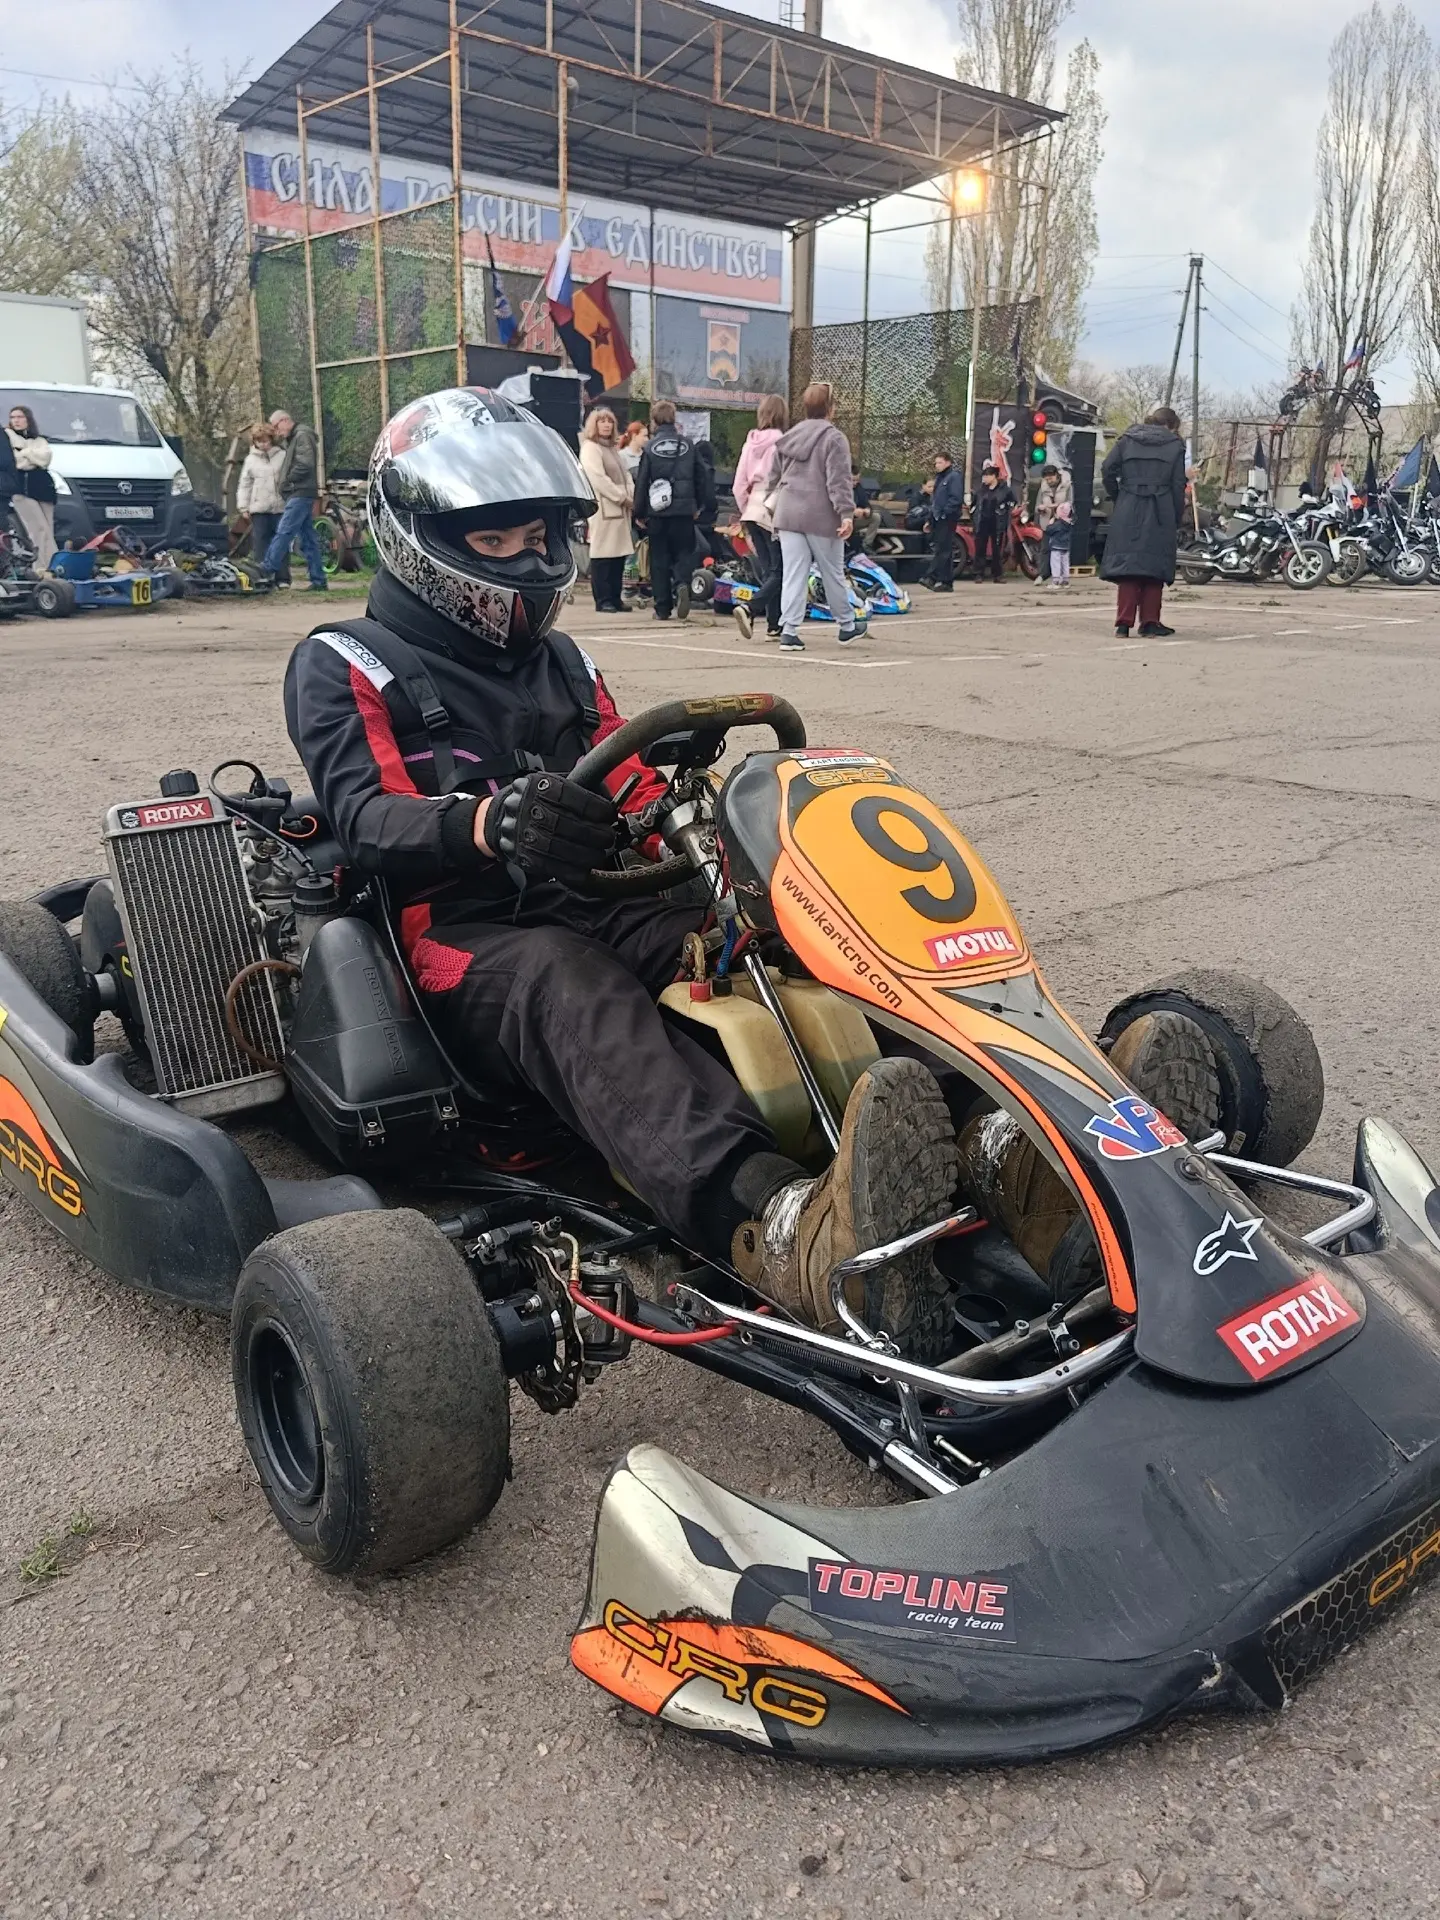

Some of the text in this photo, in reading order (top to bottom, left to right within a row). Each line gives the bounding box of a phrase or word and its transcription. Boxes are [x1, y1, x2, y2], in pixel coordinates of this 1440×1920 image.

[135, 581, 150, 601] 16
[333, 632, 378, 666] sparco
[805, 767, 892, 787] CRG
[143, 802, 207, 824] ROTAX
[851, 796, 977, 924] 9
[781, 875, 904, 1009] www.kartcrg.com
[934, 929, 1016, 965] MOTUL
[366, 970, 404, 1067] ROTAX MAX
[1086, 1098, 1164, 1155] VP
[1234, 1285, 1348, 1366] ROTAX
[813, 1562, 1009, 1617] TOPLINE
[906, 1608, 1005, 1632] racing team
[603, 1598, 830, 1729] CRG
